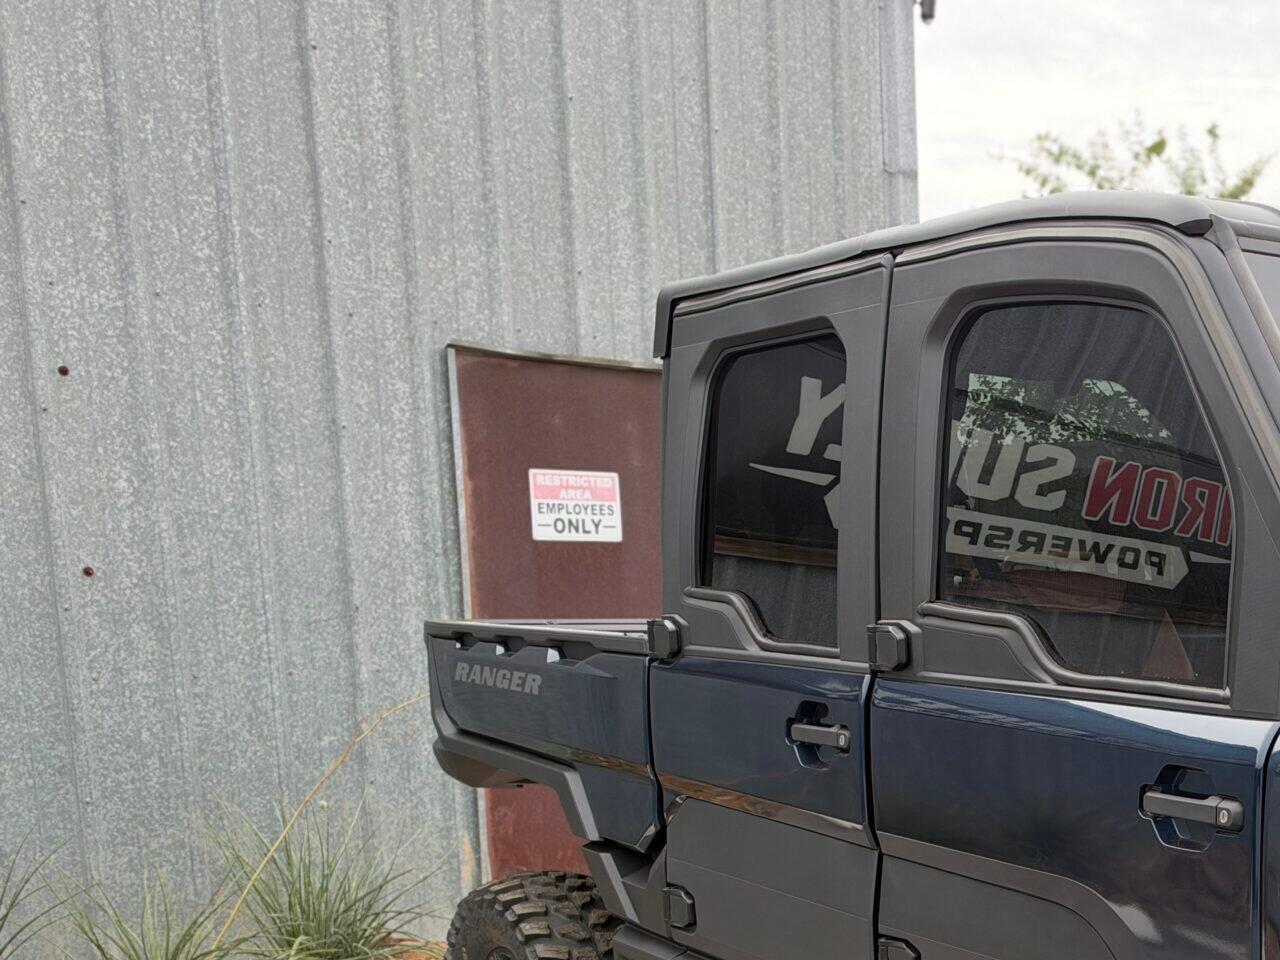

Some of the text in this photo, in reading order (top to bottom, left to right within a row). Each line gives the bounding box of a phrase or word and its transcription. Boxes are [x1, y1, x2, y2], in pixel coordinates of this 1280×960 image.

[535, 474, 612, 488] RESTRICTED
[559, 489, 593, 500] AREA
[537, 502, 615, 517] EMPLOYEES
[454, 662, 543, 696] RANGER
